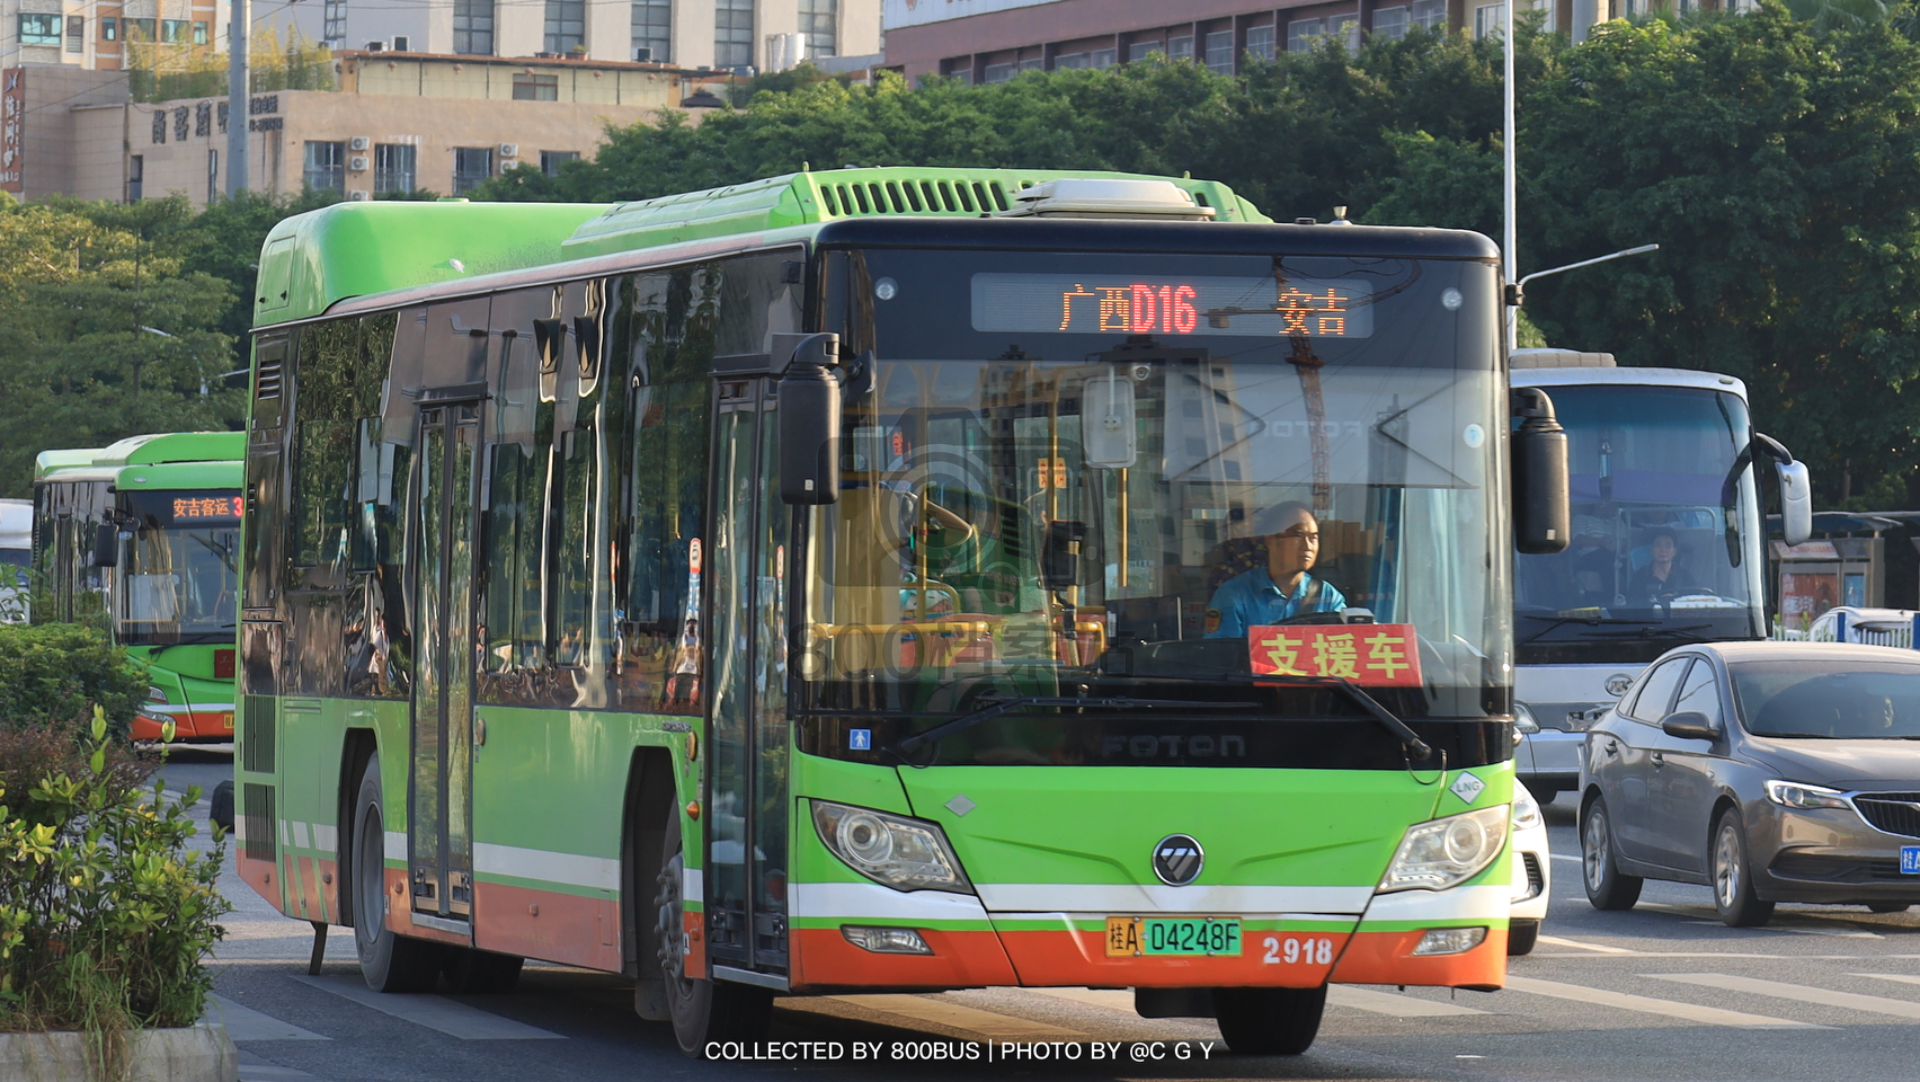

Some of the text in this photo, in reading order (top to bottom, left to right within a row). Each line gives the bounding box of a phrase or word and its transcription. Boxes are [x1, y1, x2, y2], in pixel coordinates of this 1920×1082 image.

[1276, 287, 1348, 335] 安吉
[173, 498, 230, 517] 安吉客运
[1261, 632, 1410, 679] 支援车
[1456, 781, 1480, 793] LNG
[1263, 937, 1333, 964] 2918
